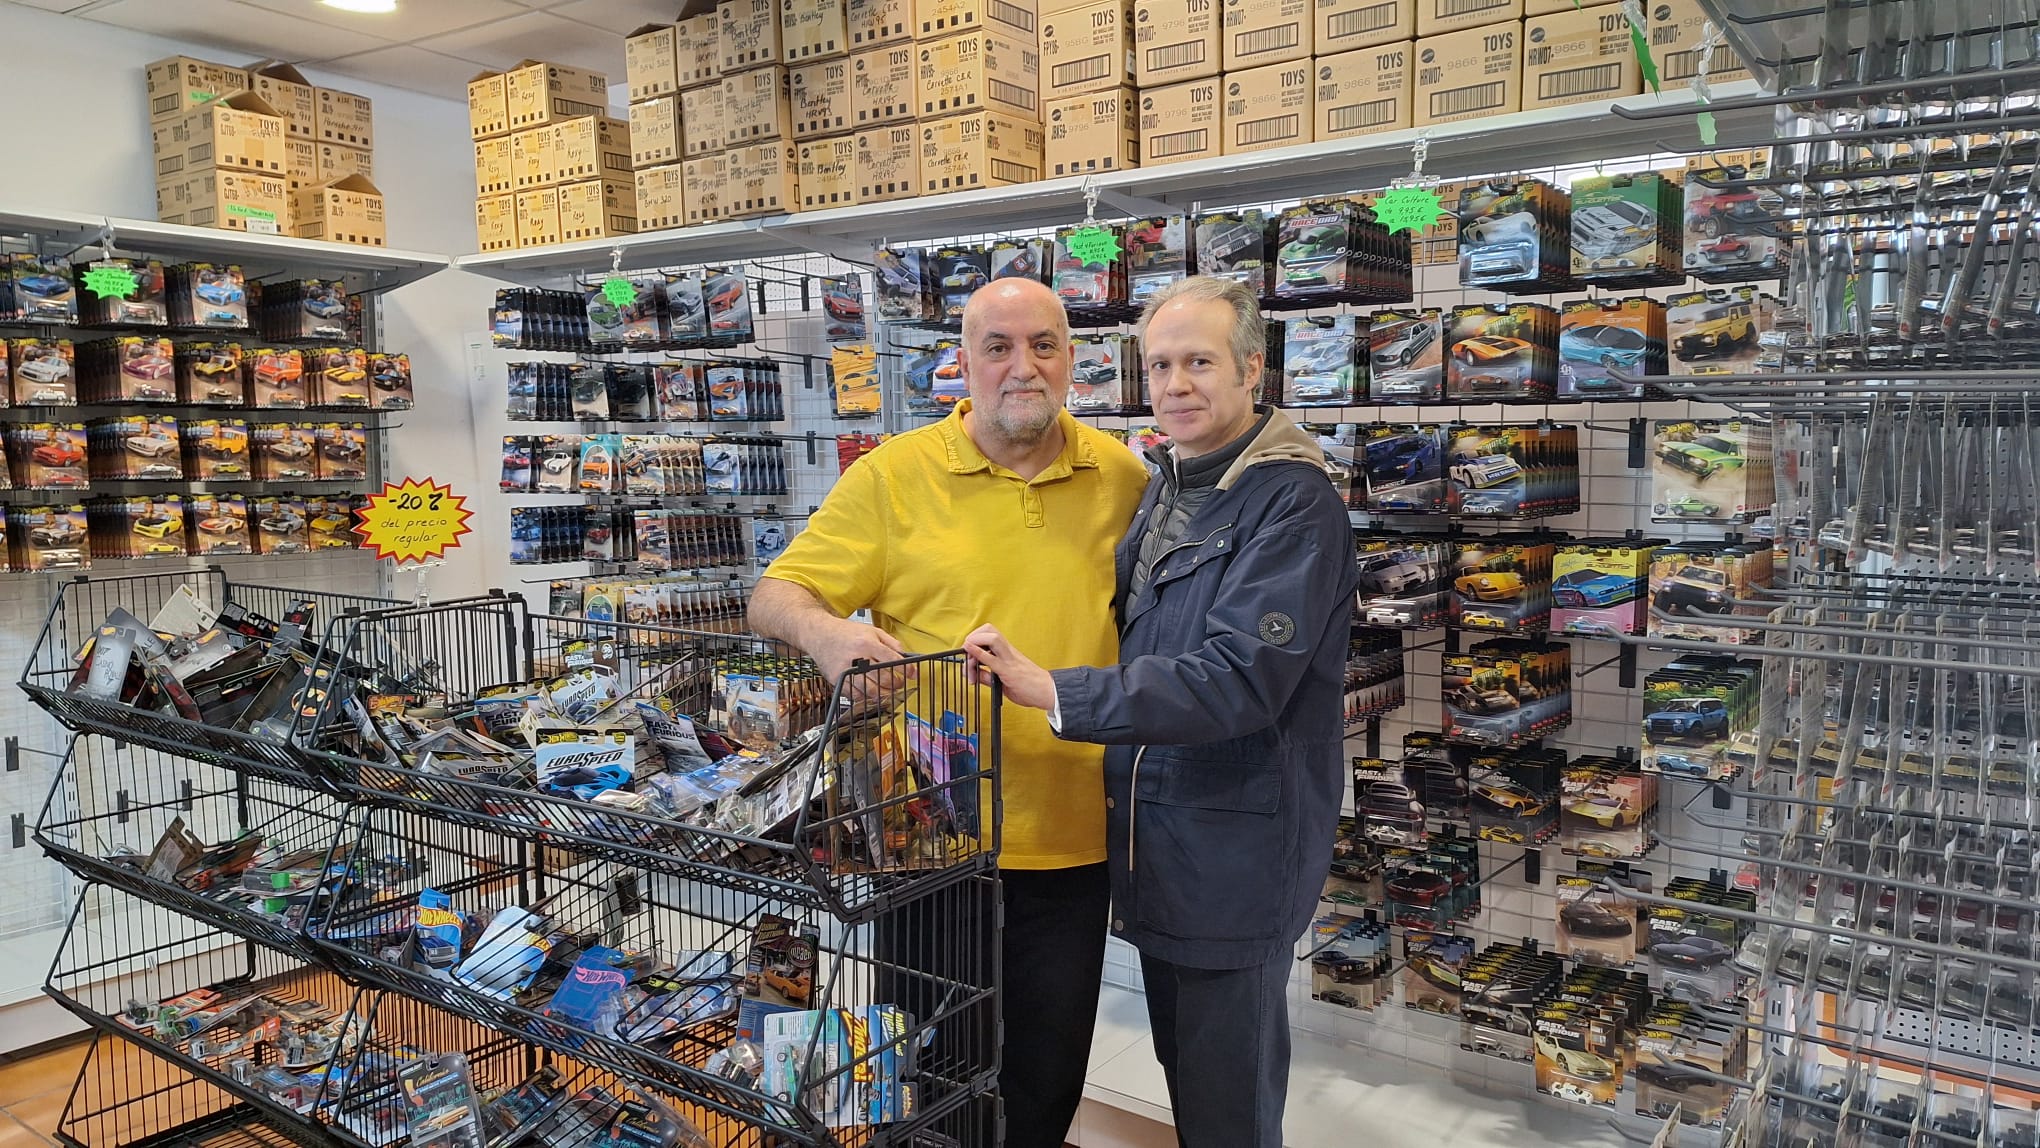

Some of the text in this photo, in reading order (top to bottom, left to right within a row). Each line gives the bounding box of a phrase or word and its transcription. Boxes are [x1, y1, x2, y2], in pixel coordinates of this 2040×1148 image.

[1091, 9, 1115, 28] TOYS
[1599, 13, 1630, 33] TOYS
[654, 33, 669, 47] TOYS
[1653, 24, 1681, 46] HRW07-
[957, 38, 978, 54] TOYS
[1483, 32, 1513, 53] TOYS
[1554, 41, 1586, 54] 9866
[889, 50, 909, 66] TOYS
[1376, 51, 1403, 72] TOYS
[1447, 57, 1478, 71] 9866
[224, 70, 244, 87] TOYS
[530, 66, 542, 79] TOYS
[826, 65, 844, 80] TOYS
[1280, 69, 1305, 88] TOYS
[489, 80, 501, 92] TOYS
[589, 75, 606, 88] TOYS
[754, 73, 771, 87] TOYS
[926, 74, 952, 91] Corvette
[1343, 78, 1371, 90] 9866
[294, 86, 311, 99] TOYS
[1190, 86, 1213, 104] TOYS
[354, 98, 370, 111] TOYS
[656, 102, 671, 116] TOYS
[1092, 99, 1116, 116] TOYS
[258, 118, 280, 132] TOYS
[578, 120, 592, 133] TOYS
[960, 118, 980, 135] TOYS
[537, 131, 550, 144] TOYS
[891, 129, 911, 143] TOYS
[1025, 129, 1040, 145] TOYS
[296, 143, 312, 155] TOYS
[496, 141, 508, 154] TOYS
[760, 147, 777, 161] TOYS
[834, 141, 853, 155] TOYS
[355, 152, 371, 164] TOYS
[1728, 154, 1745, 163] TOYS
[664, 170, 679, 183] TOYS
[261, 181, 283, 195] TOYS
[586, 184, 600, 197] TOYS
[365, 198, 382, 211] TOYS
[498, 198, 510, 211] TOYS
[542, 192, 555, 205] TOYS
[1384, 195, 1397, 205] Car
[1401, 195, 1429, 204] Culture
[381, 519, 447, 532] del precio
[394, 531, 438, 549] regular
[652, 727, 696, 741] FURIOUS
[546, 750, 625, 768] EUROSPEED
[420, 910, 462, 926] HOT WHEELS
[585, 971, 625, 985] HOT WHEELS
[1539, 1026, 1580, 1039] FURIOUS
